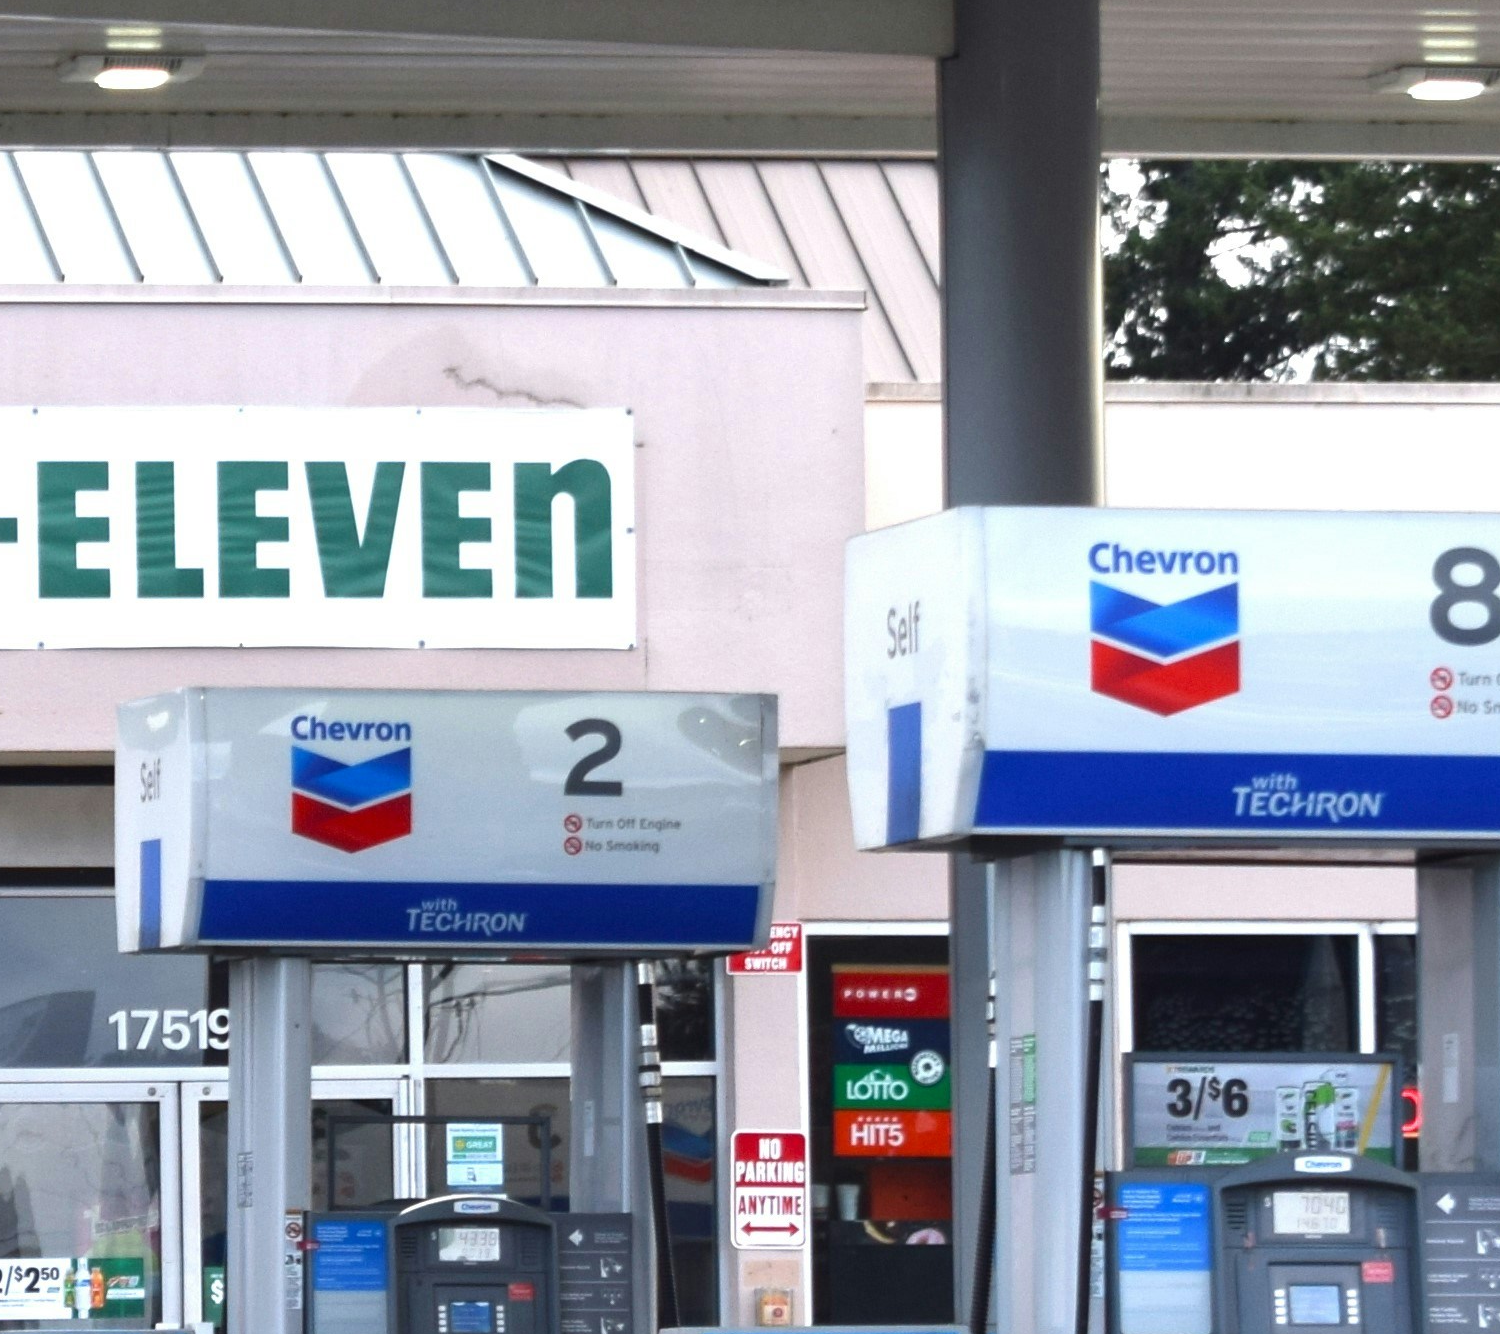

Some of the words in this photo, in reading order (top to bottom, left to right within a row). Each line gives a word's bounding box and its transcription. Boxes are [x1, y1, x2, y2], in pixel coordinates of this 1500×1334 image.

[1088, 542, 1239, 575] Chevron
[886, 600, 920, 659] Self
[1458, 673, 1492, 686] Turn
[1457, 701, 1478, 714] No
[291, 715, 411, 742] Chevron
[564, 718, 623, 797] 2
[140, 758, 161, 803] Self
[1251, 773, 1297, 790] with
[1233, 785, 1383, 823] TECHRON
[587, 818, 614, 830] Turn
[617, 818, 636, 830] Off
[639, 818, 682, 833] Engine
[585, 840, 602, 852] No
[606, 840, 660, 854] Smoking
[421, 898, 458, 912] with
[406, 908, 526, 936] TECHRON
[744, 958, 787, 970] SWITCH
[108, 1008, 230, 1051] 17519
[865, 1026, 908, 1044] MEGA
[846, 1079, 908, 1100] LOTTO
[1167, 1076, 1248, 1121] 3/$6
[850, 1123, 904, 1147] HIT5
[759, 1138, 781, 1160] NO
[736, 1161, 805, 1183] PARKING
[1304, 1160, 1342, 1169] Chevron
[738, 1195, 802, 1215] ANYTIME
